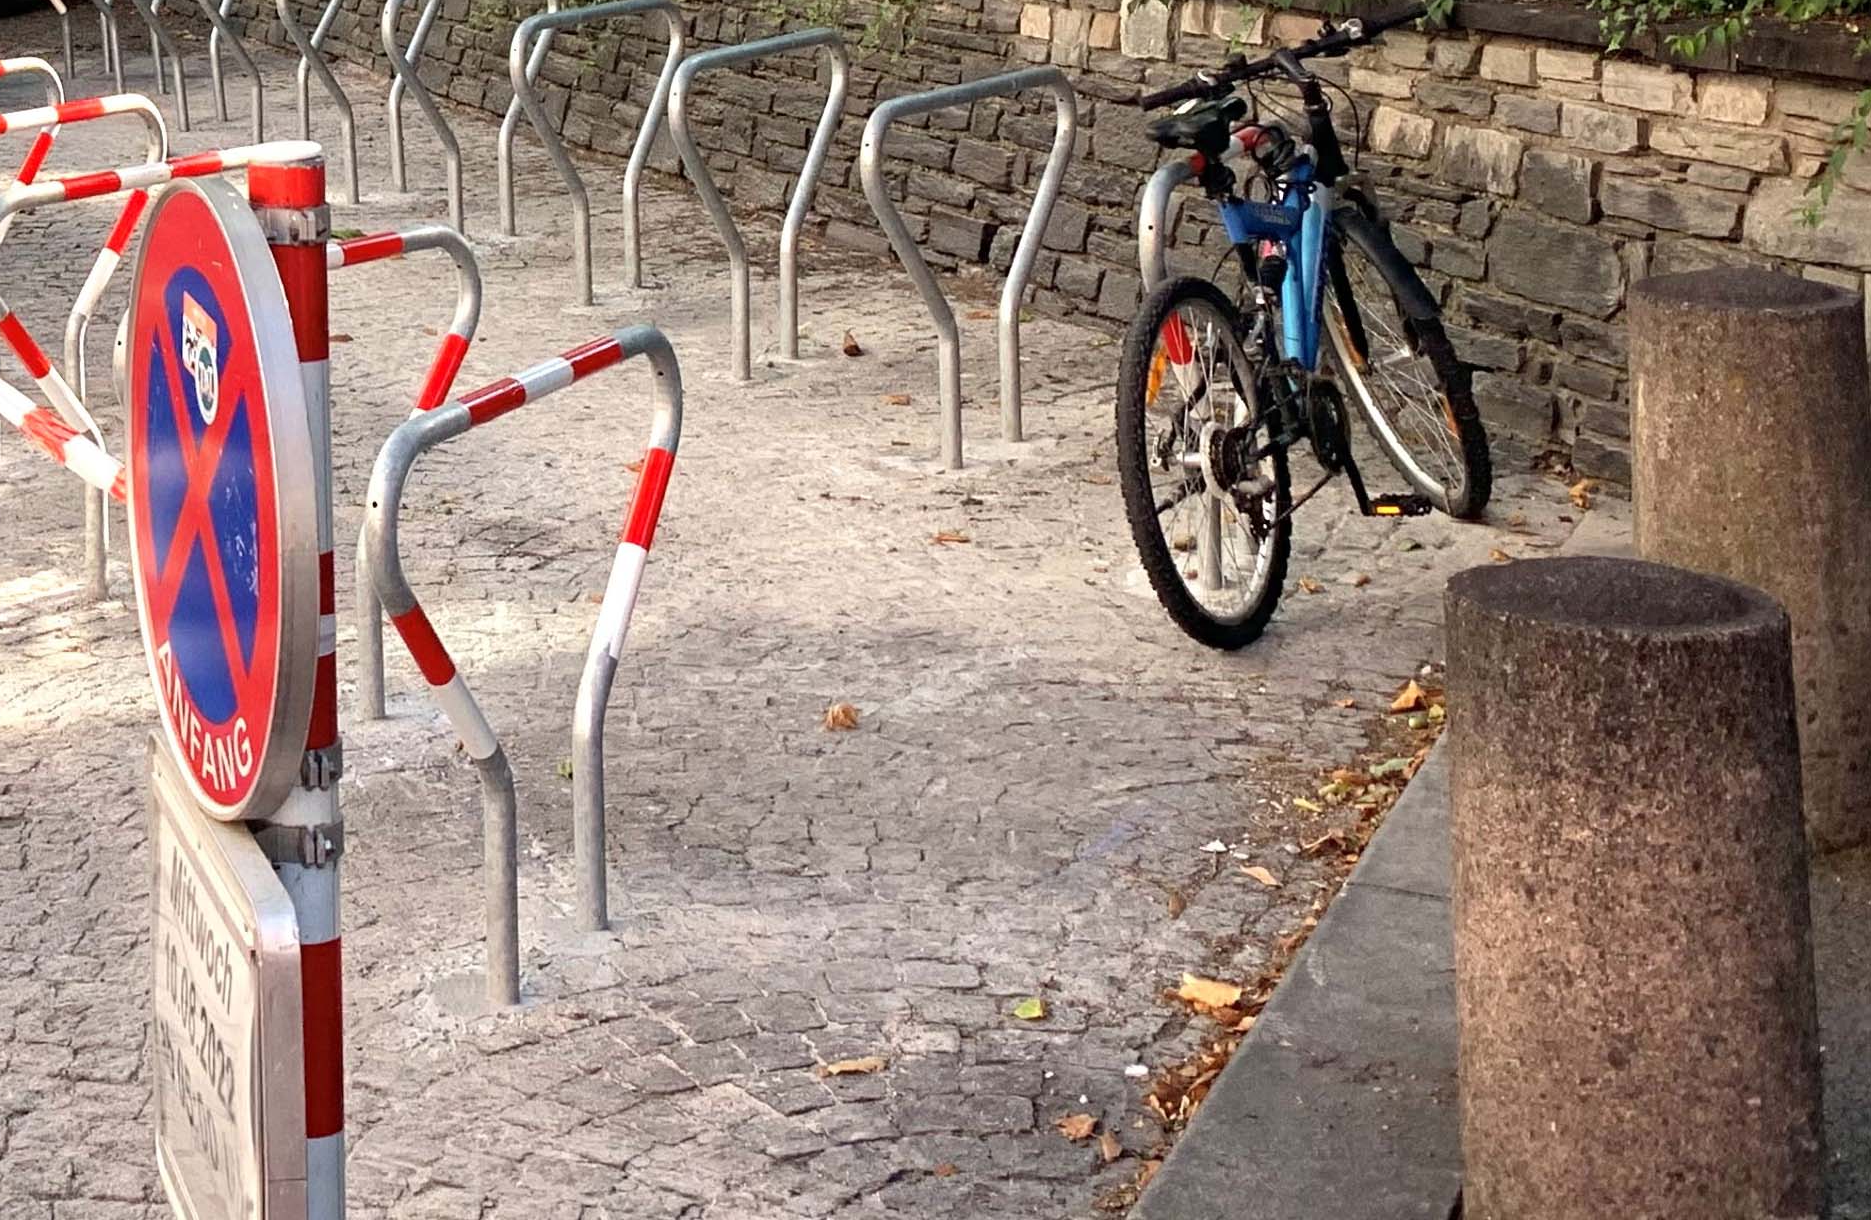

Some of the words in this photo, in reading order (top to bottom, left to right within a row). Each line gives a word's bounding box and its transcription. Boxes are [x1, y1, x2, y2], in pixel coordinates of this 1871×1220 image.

[157, 639, 254, 792] ANFANG
[169, 845, 233, 1017] Mittwoch
[164, 933, 237, 1127] 10.08.2022
